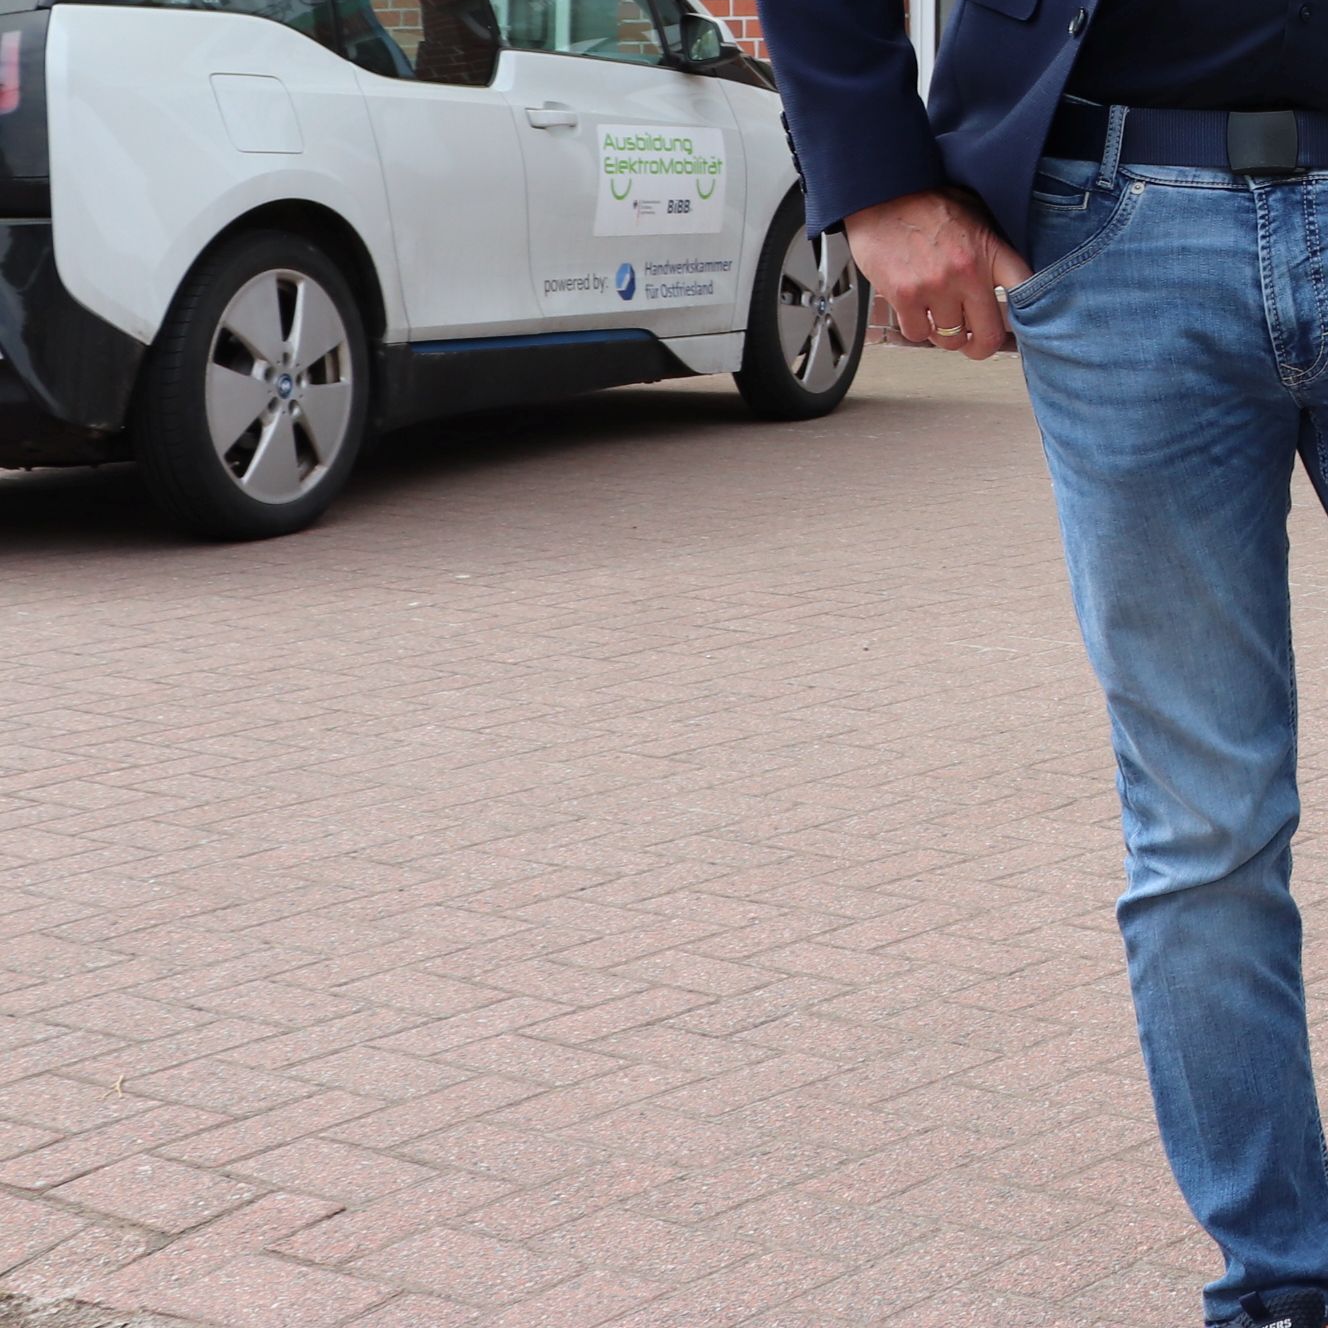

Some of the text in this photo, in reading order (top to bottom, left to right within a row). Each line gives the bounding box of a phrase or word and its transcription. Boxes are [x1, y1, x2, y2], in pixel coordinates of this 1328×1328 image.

[603, 132, 693, 155] Ausbildung
[603, 156, 723, 174] ElektroMobilität
[644, 258, 733, 276] Handwerkskammer
[543, 273, 609, 296] powered by:
[645, 279, 714, 299] für Ostfriesland
